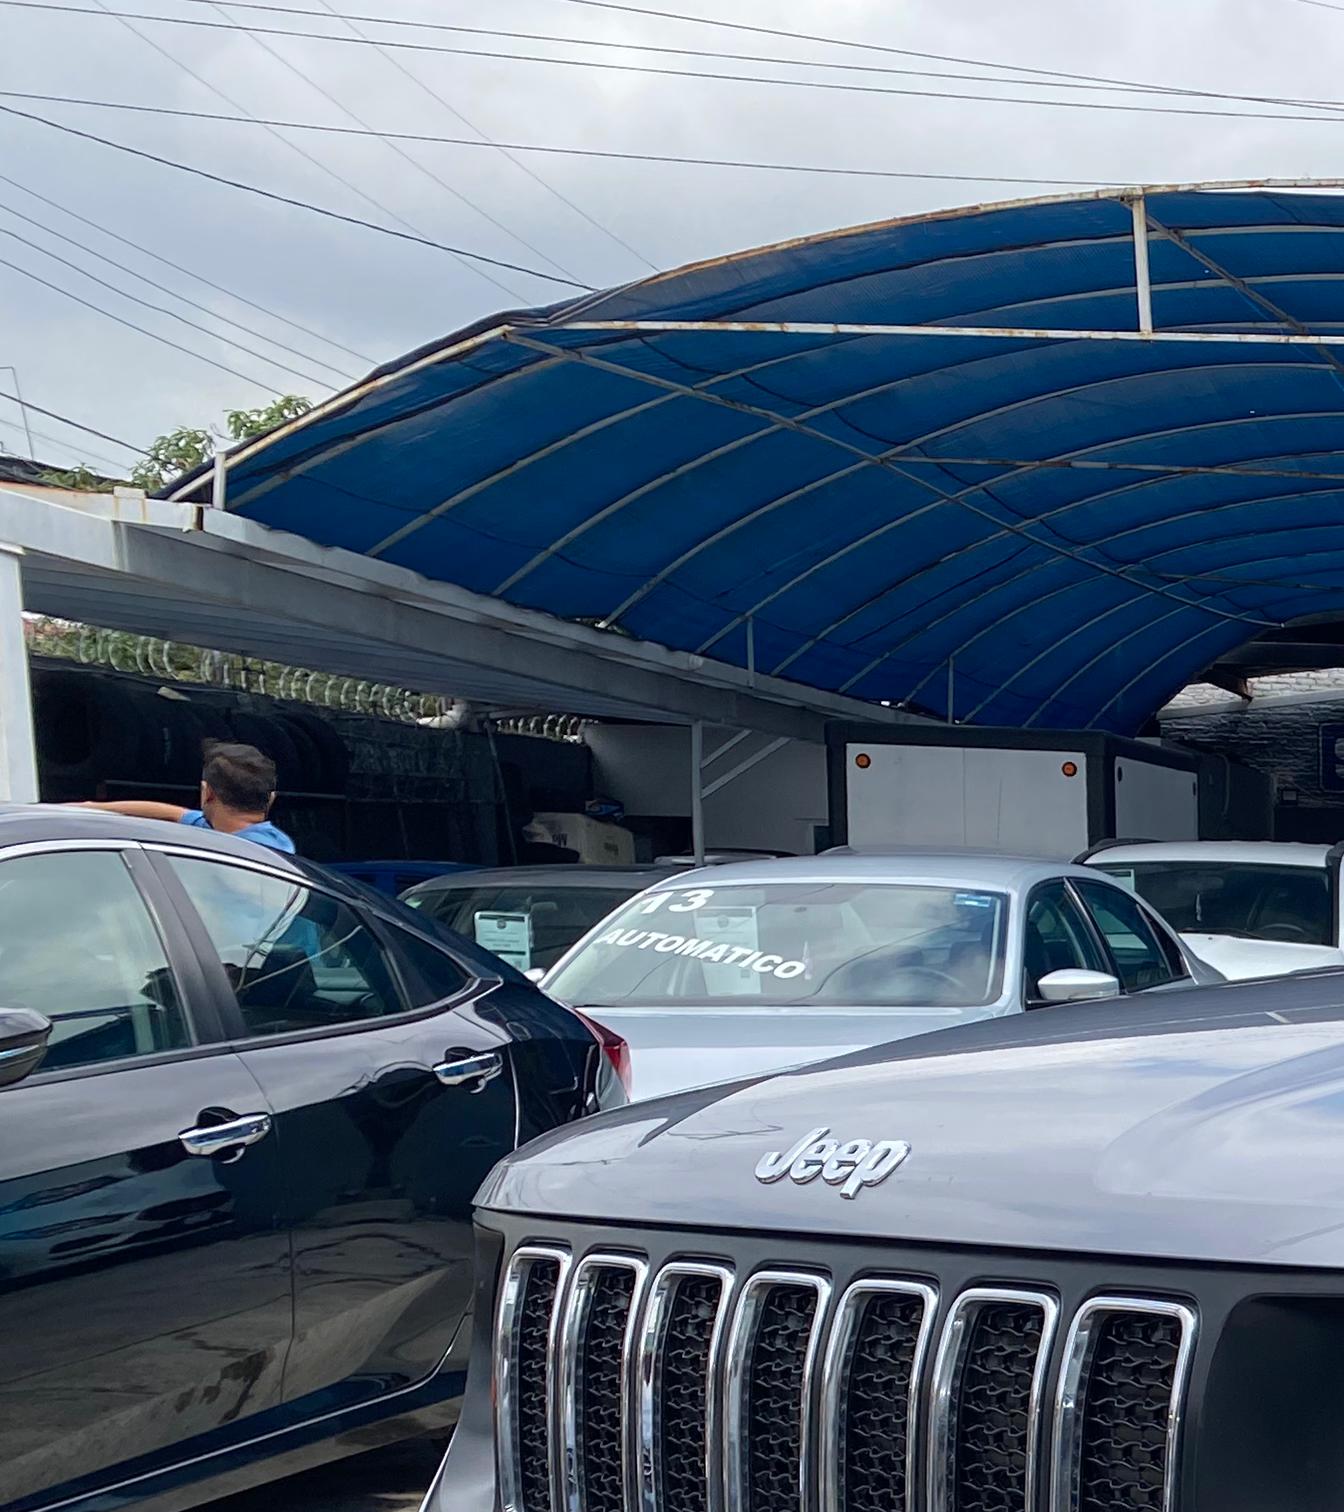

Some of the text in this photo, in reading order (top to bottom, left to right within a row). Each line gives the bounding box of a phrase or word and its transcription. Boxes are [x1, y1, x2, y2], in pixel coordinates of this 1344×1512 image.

[640, 889, 714, 914] 13
[594, 928, 806, 978] AUTOMATICO
[755, 1127, 911, 1200] Jeep
